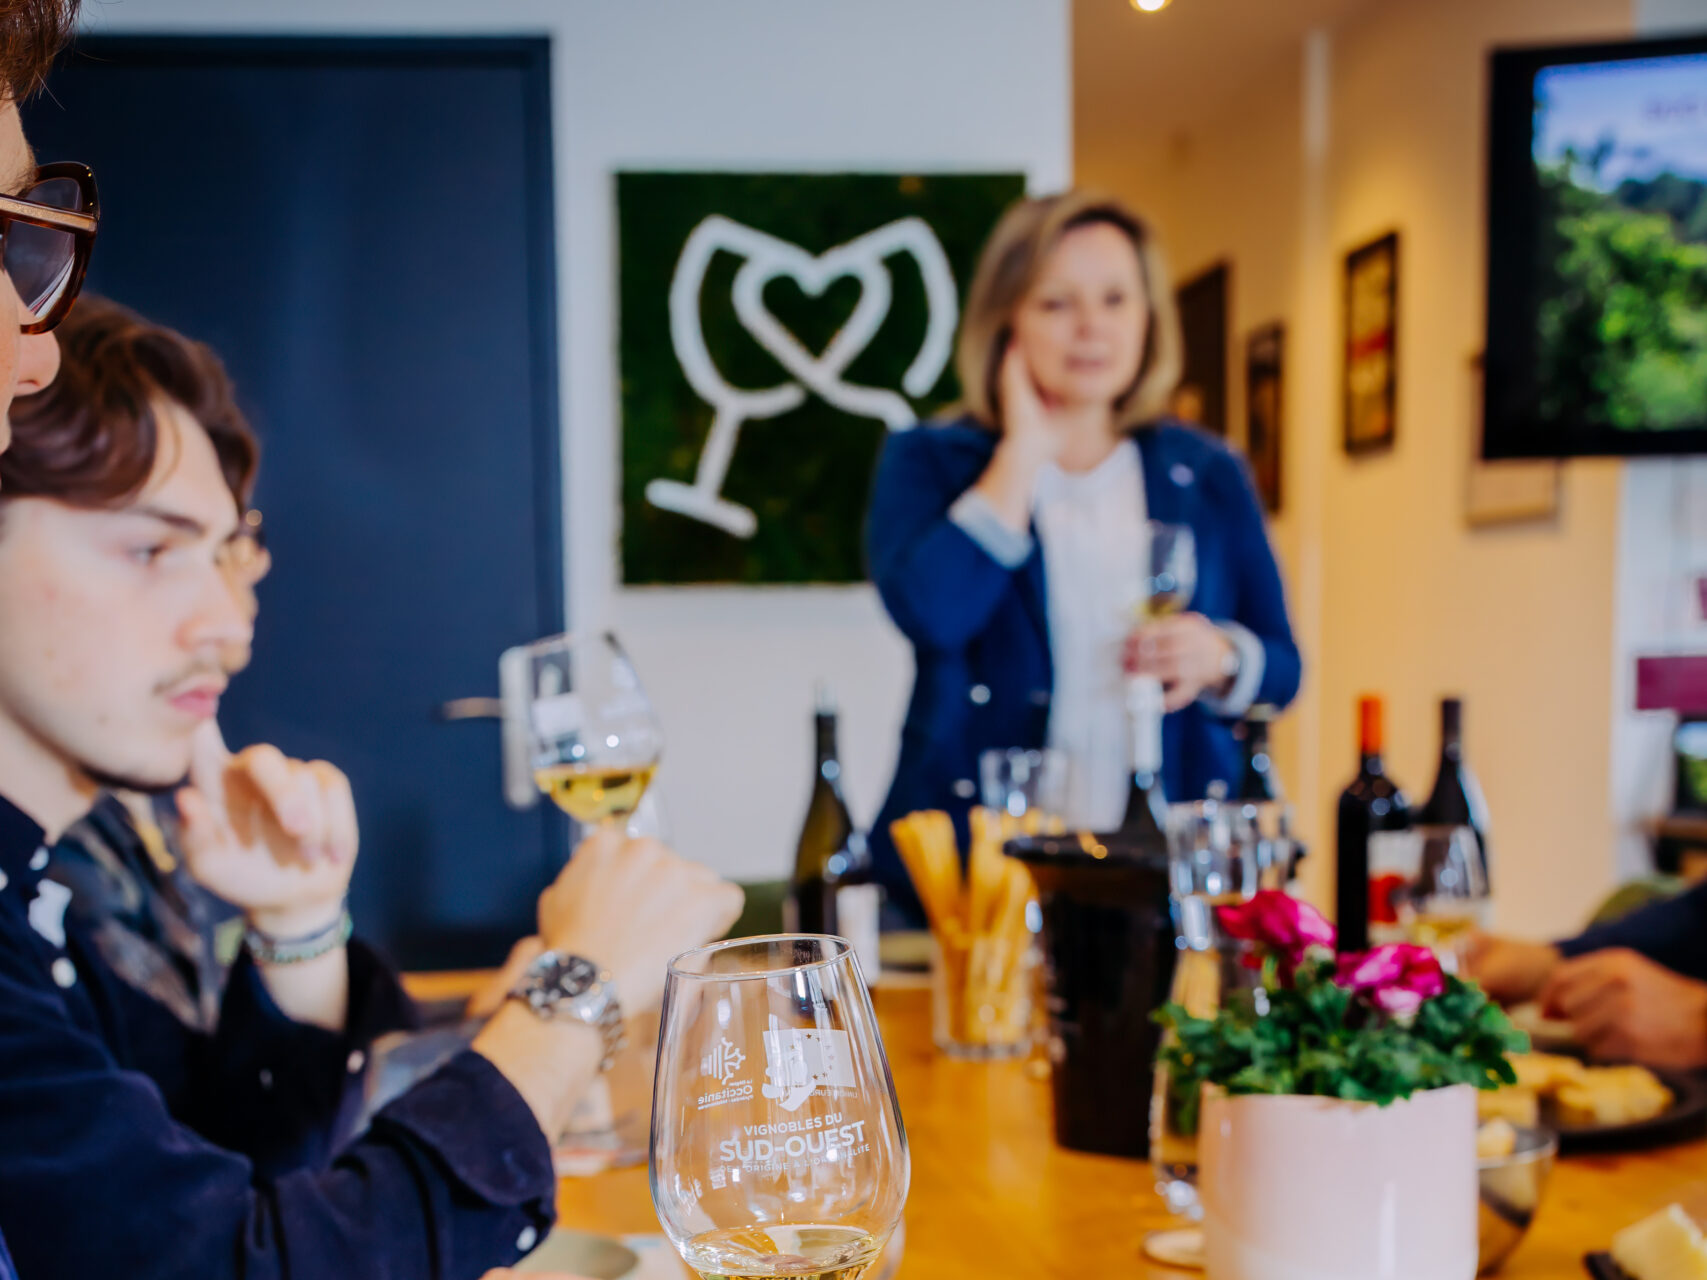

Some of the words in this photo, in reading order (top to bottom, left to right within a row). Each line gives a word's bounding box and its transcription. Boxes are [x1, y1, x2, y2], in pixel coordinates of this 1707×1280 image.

[719, 1120, 865, 1162] SUD-OUEST
[743, 1116, 823, 1137] VIGNOBLES
[825, 1112, 843, 1127] DU
